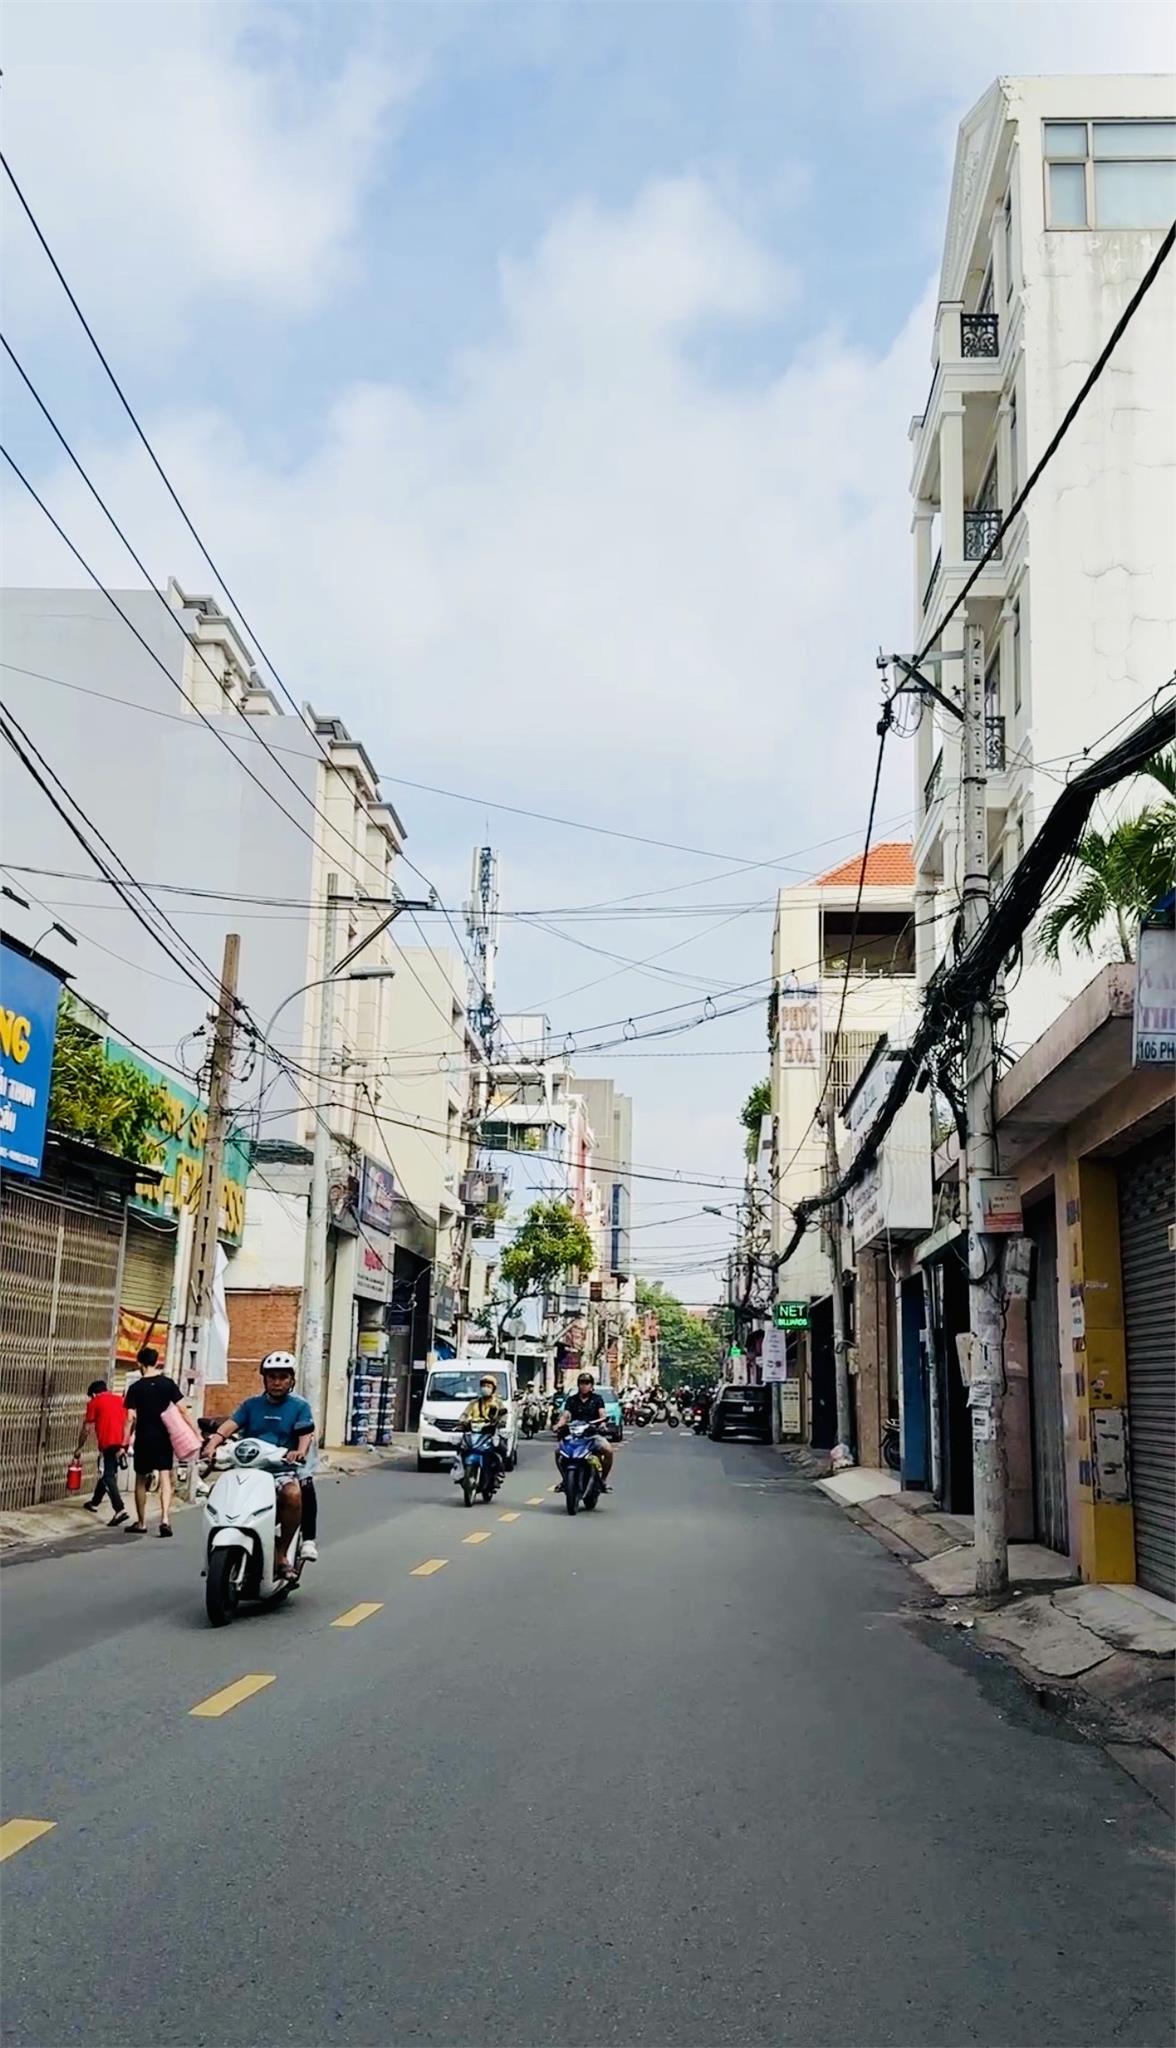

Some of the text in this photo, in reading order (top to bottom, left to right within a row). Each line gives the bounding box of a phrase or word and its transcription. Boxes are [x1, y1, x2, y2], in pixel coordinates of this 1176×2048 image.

[782, 1001, 818, 1031] PHÚC
[784, 1032, 816, 1063] HÒA
[780, 1305, 805, 1317] NET
